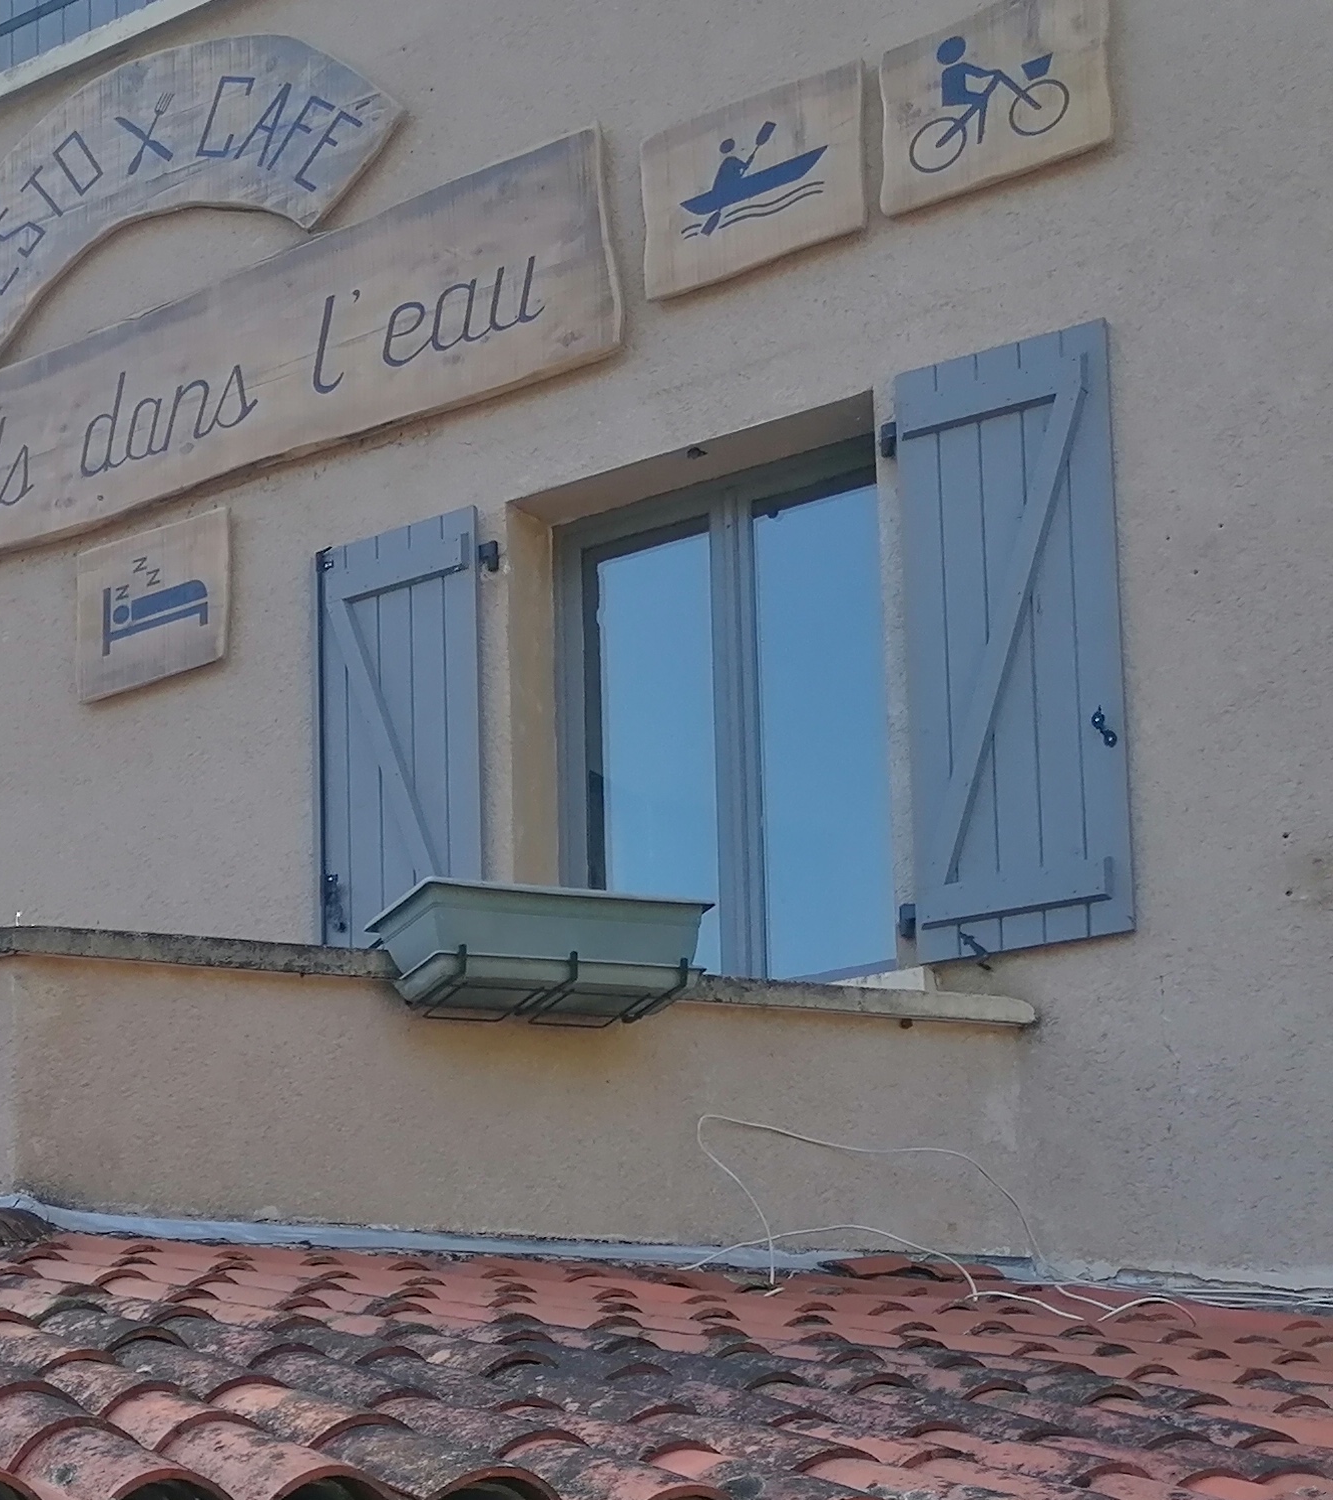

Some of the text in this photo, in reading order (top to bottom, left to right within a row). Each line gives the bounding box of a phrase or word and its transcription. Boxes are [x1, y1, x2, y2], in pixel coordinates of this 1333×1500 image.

[196, 75, 372, 193] CAFÉ
[81, 364, 259, 477] dans
[312, 255, 546, 395] l'eau
